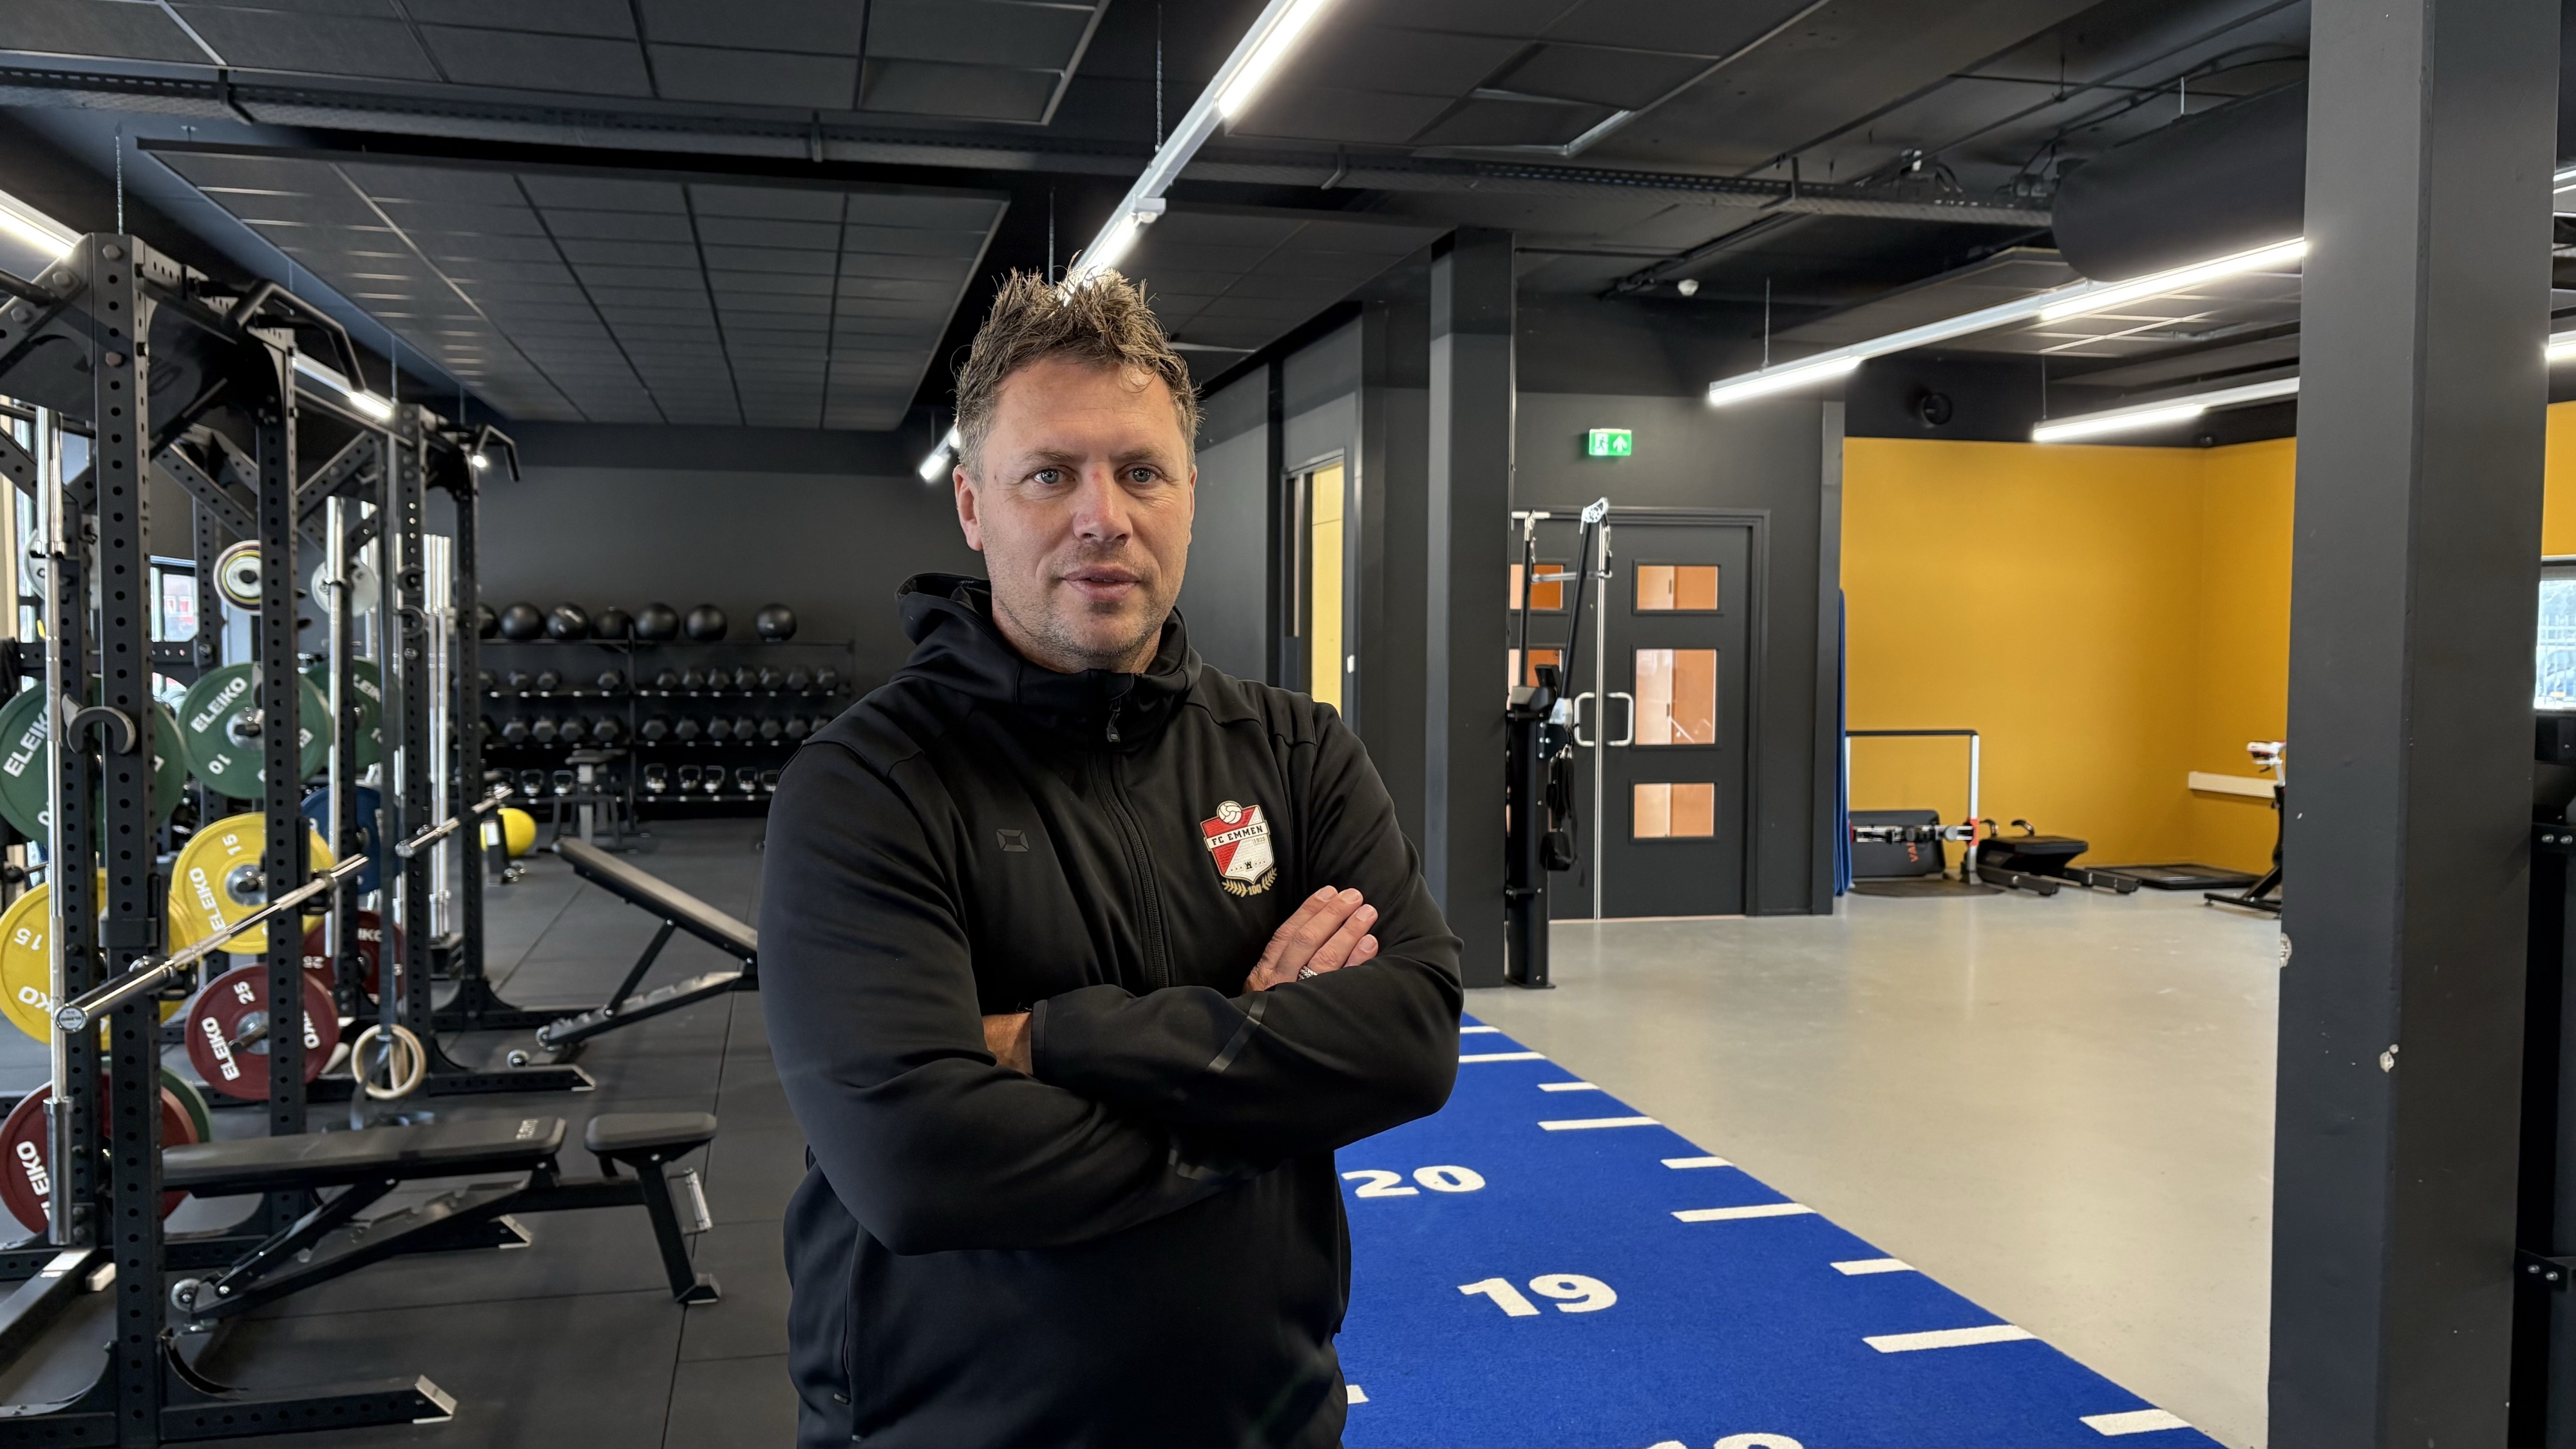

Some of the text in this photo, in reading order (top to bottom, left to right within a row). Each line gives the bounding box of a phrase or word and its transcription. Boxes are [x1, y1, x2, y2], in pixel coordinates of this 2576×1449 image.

[191, 677, 248, 733] ELEIKO
[3, 704, 48, 777] ELEIK
[208, 753, 231, 774] 10
[222, 833, 243, 855] 15
[1212, 825, 1263, 846] FC EMMEN
[189, 867, 226, 933] ELEIKO
[14, 927, 43, 951] 15
[233, 981, 256, 1005] 25
[201, 1016, 241, 1081] ELEIKO
[1341, 1165, 1486, 1198] 20
[1457, 1273, 1618, 1318] 19
